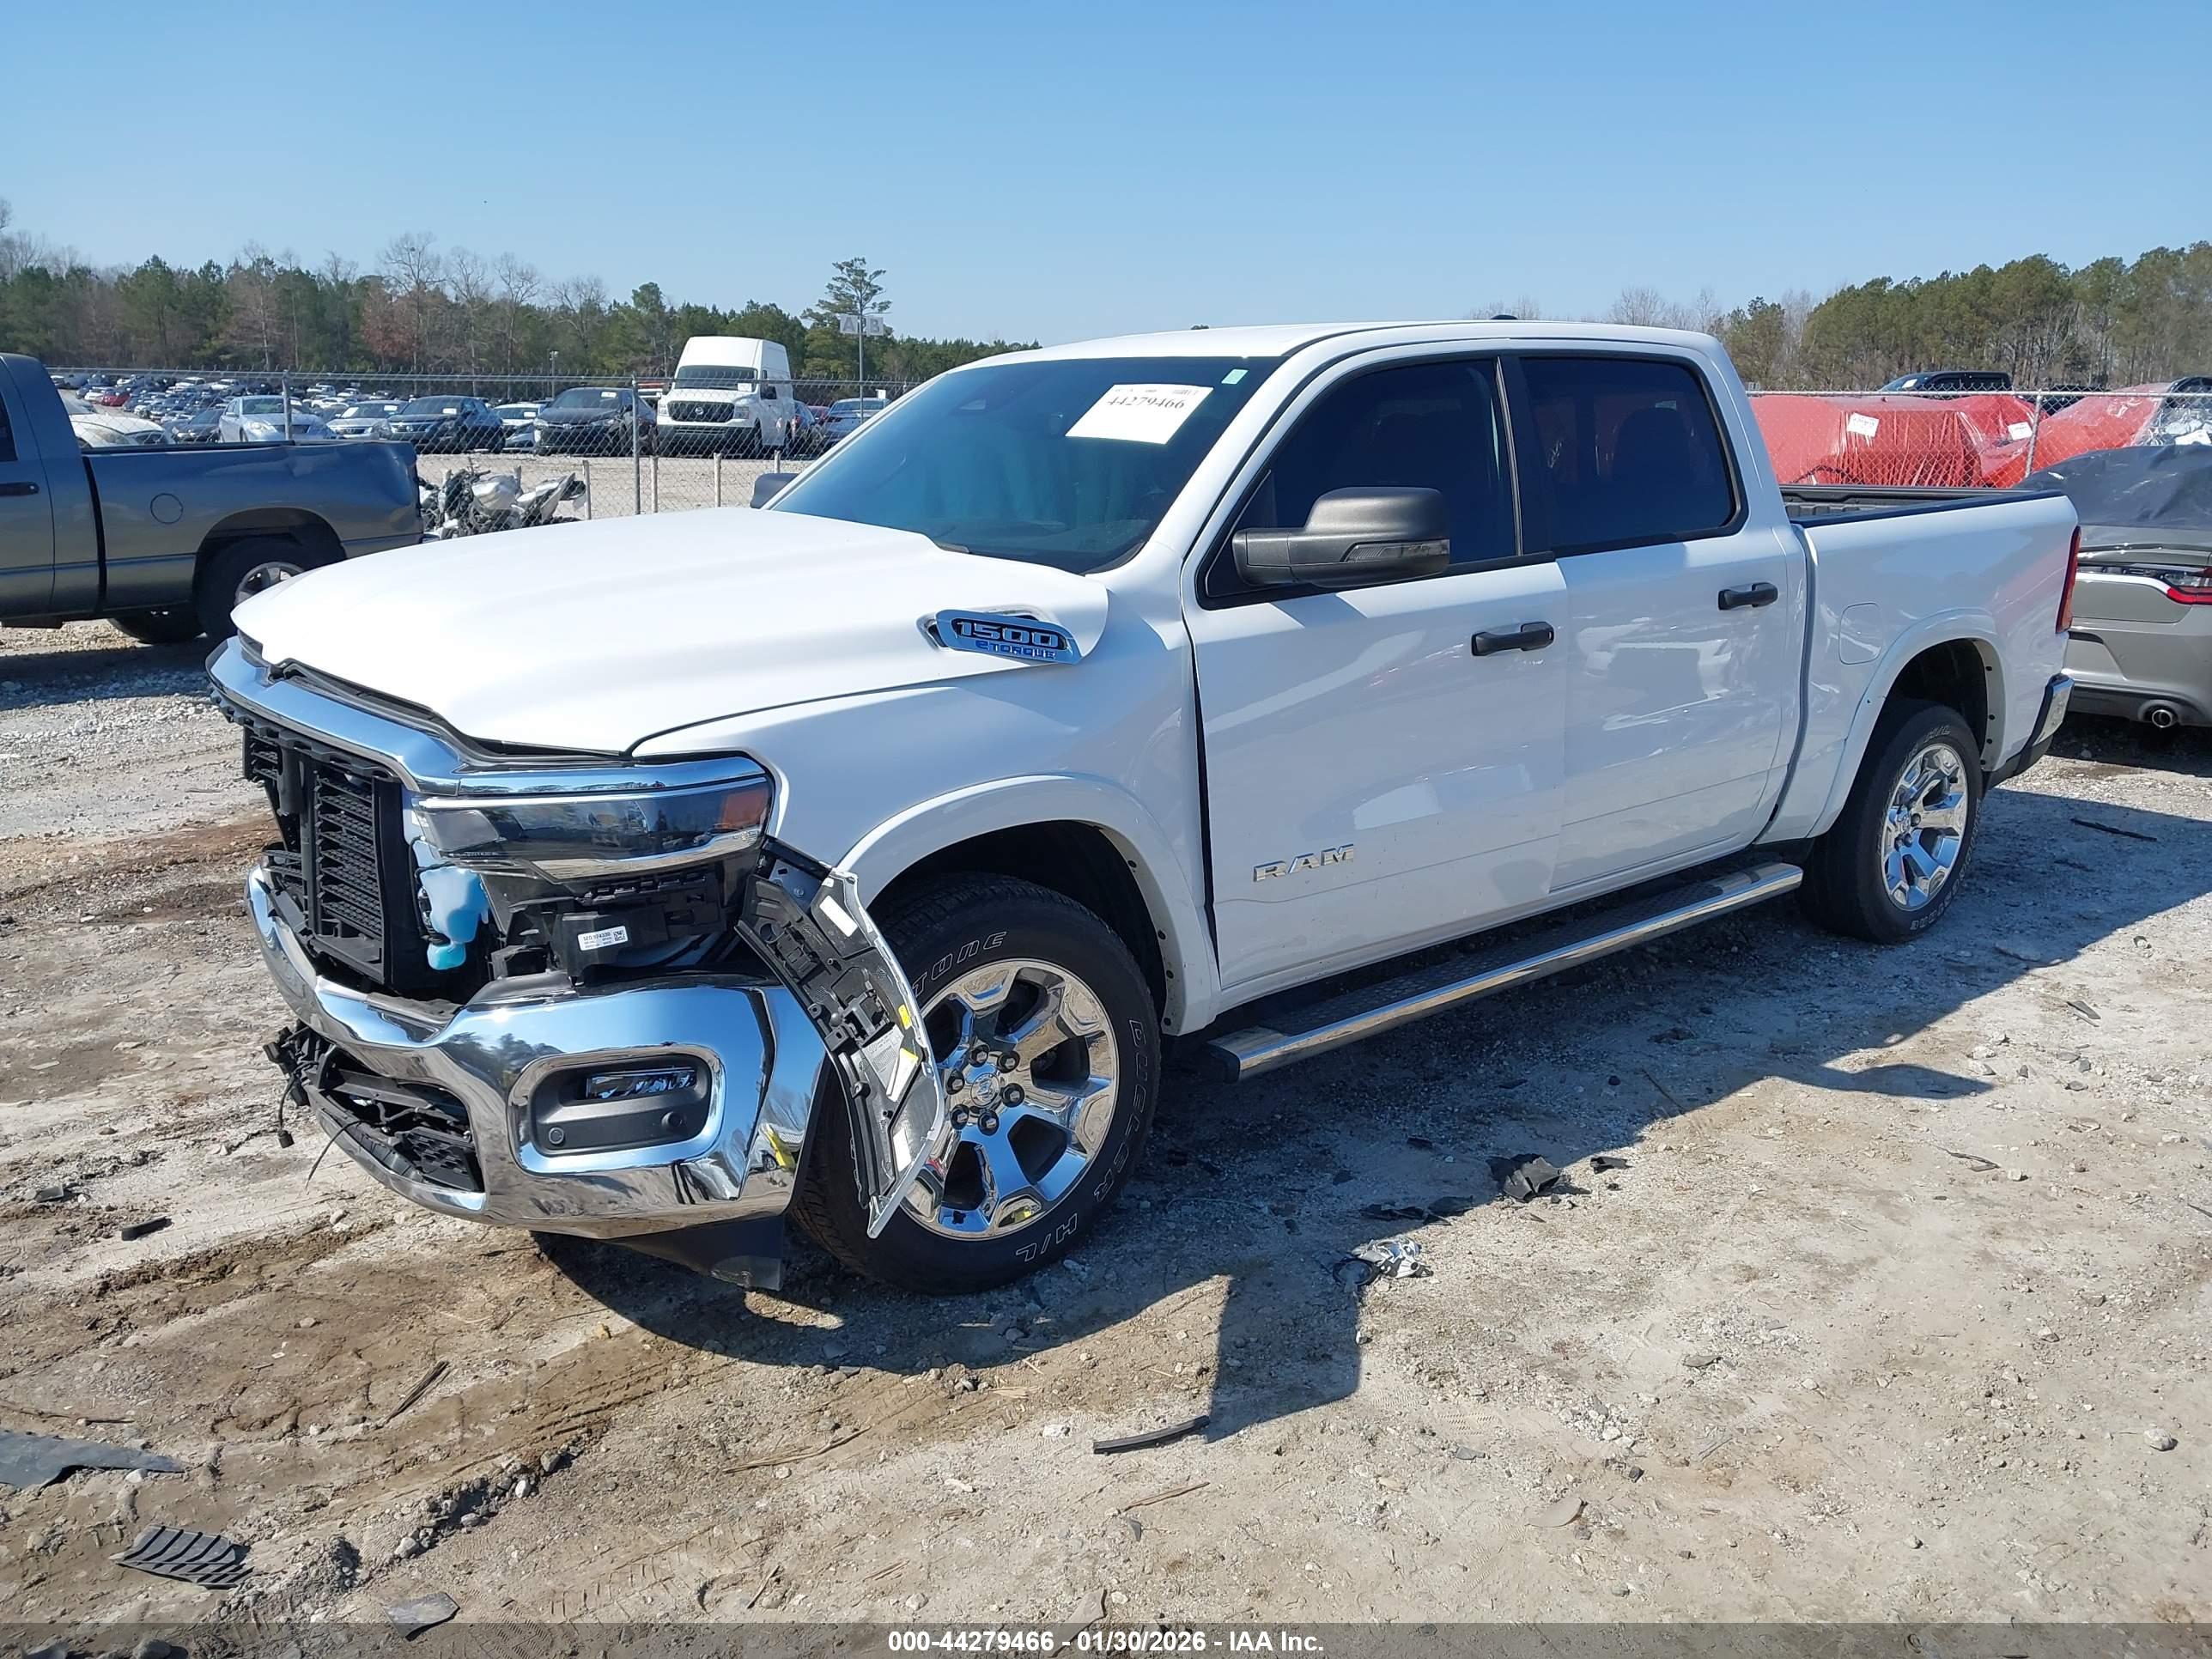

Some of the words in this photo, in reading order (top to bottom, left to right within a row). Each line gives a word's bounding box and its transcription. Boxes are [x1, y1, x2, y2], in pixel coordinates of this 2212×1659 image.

[842, 317, 855, 331] A
[870, 318, 880, 333] B
[1108, 396, 1185, 409] 44279466
[957, 620, 1060, 648] 1500
[1254, 843, 1354, 883] RAM
[1093, 1018, 1150, 1203] DUELER
[1016, 1212, 1078, 1262] H/L
